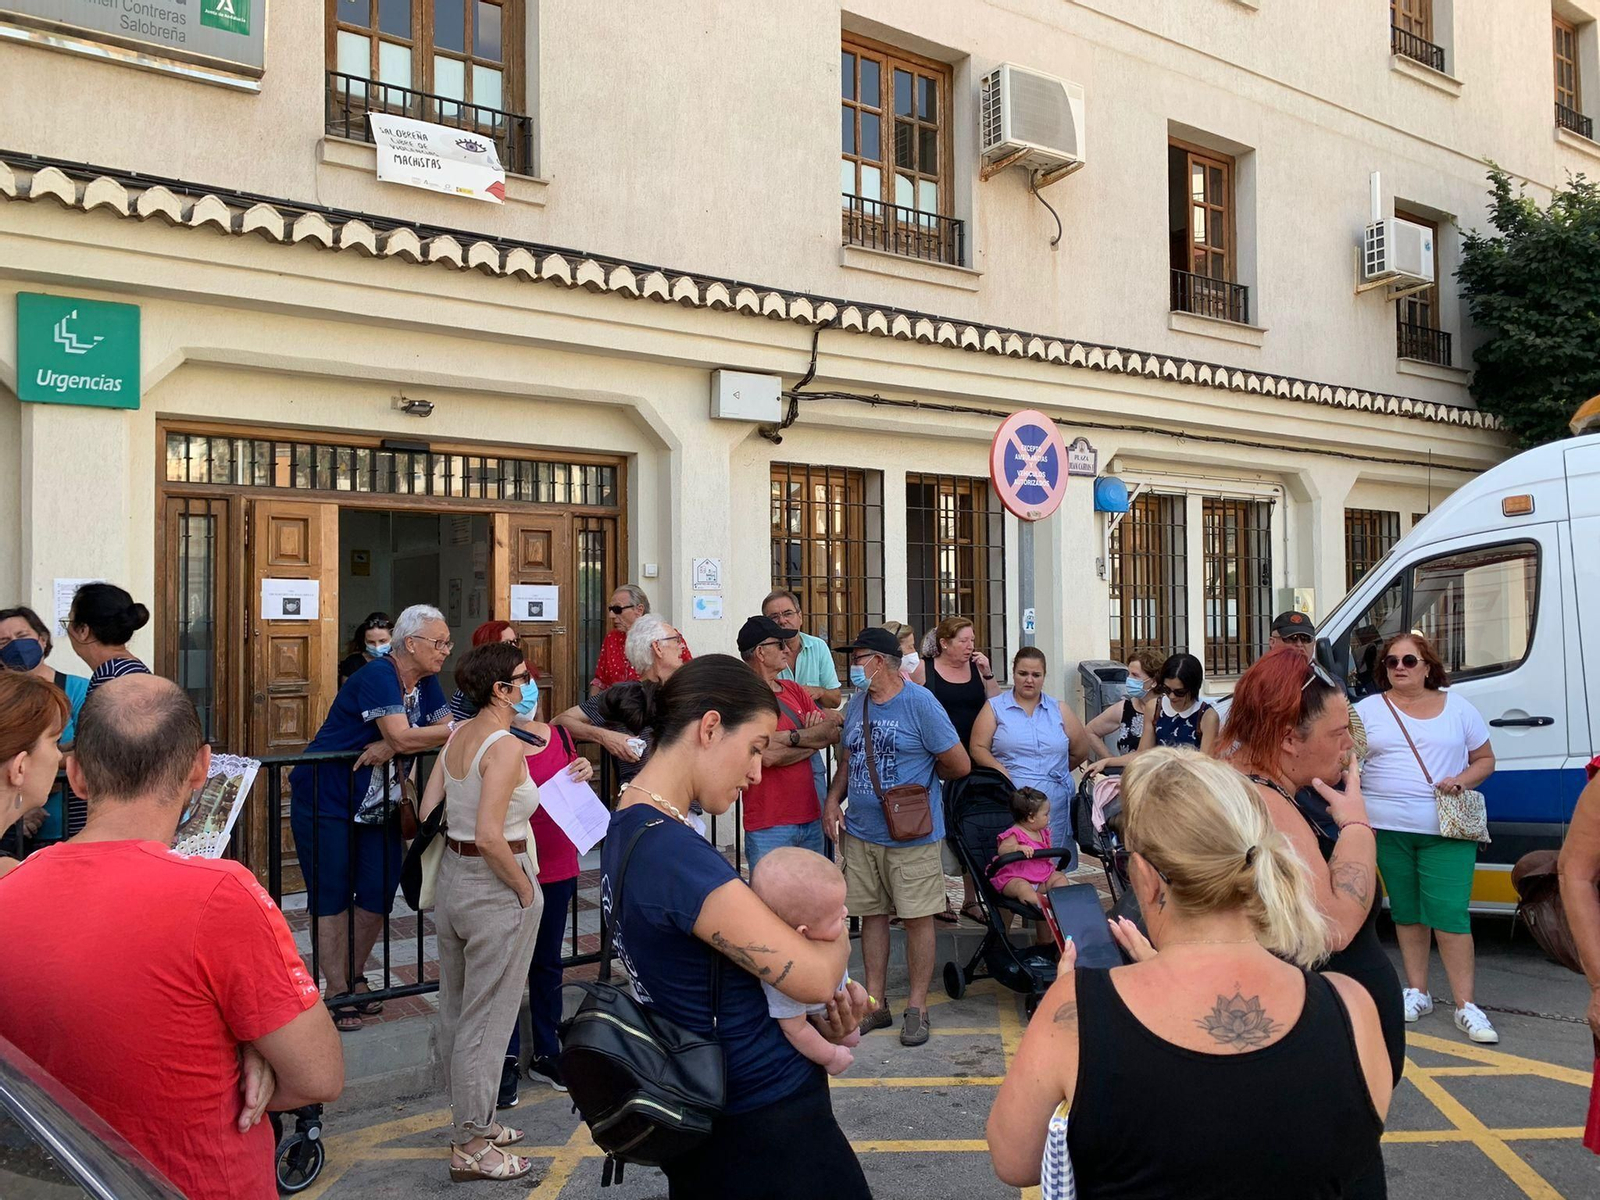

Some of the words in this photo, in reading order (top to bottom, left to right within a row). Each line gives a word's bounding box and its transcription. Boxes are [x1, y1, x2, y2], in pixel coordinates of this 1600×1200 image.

[122, 0, 187, 26] Contreras
[119, 14, 187, 43] Salobreña
[36, 368, 123, 392] Urgencias
